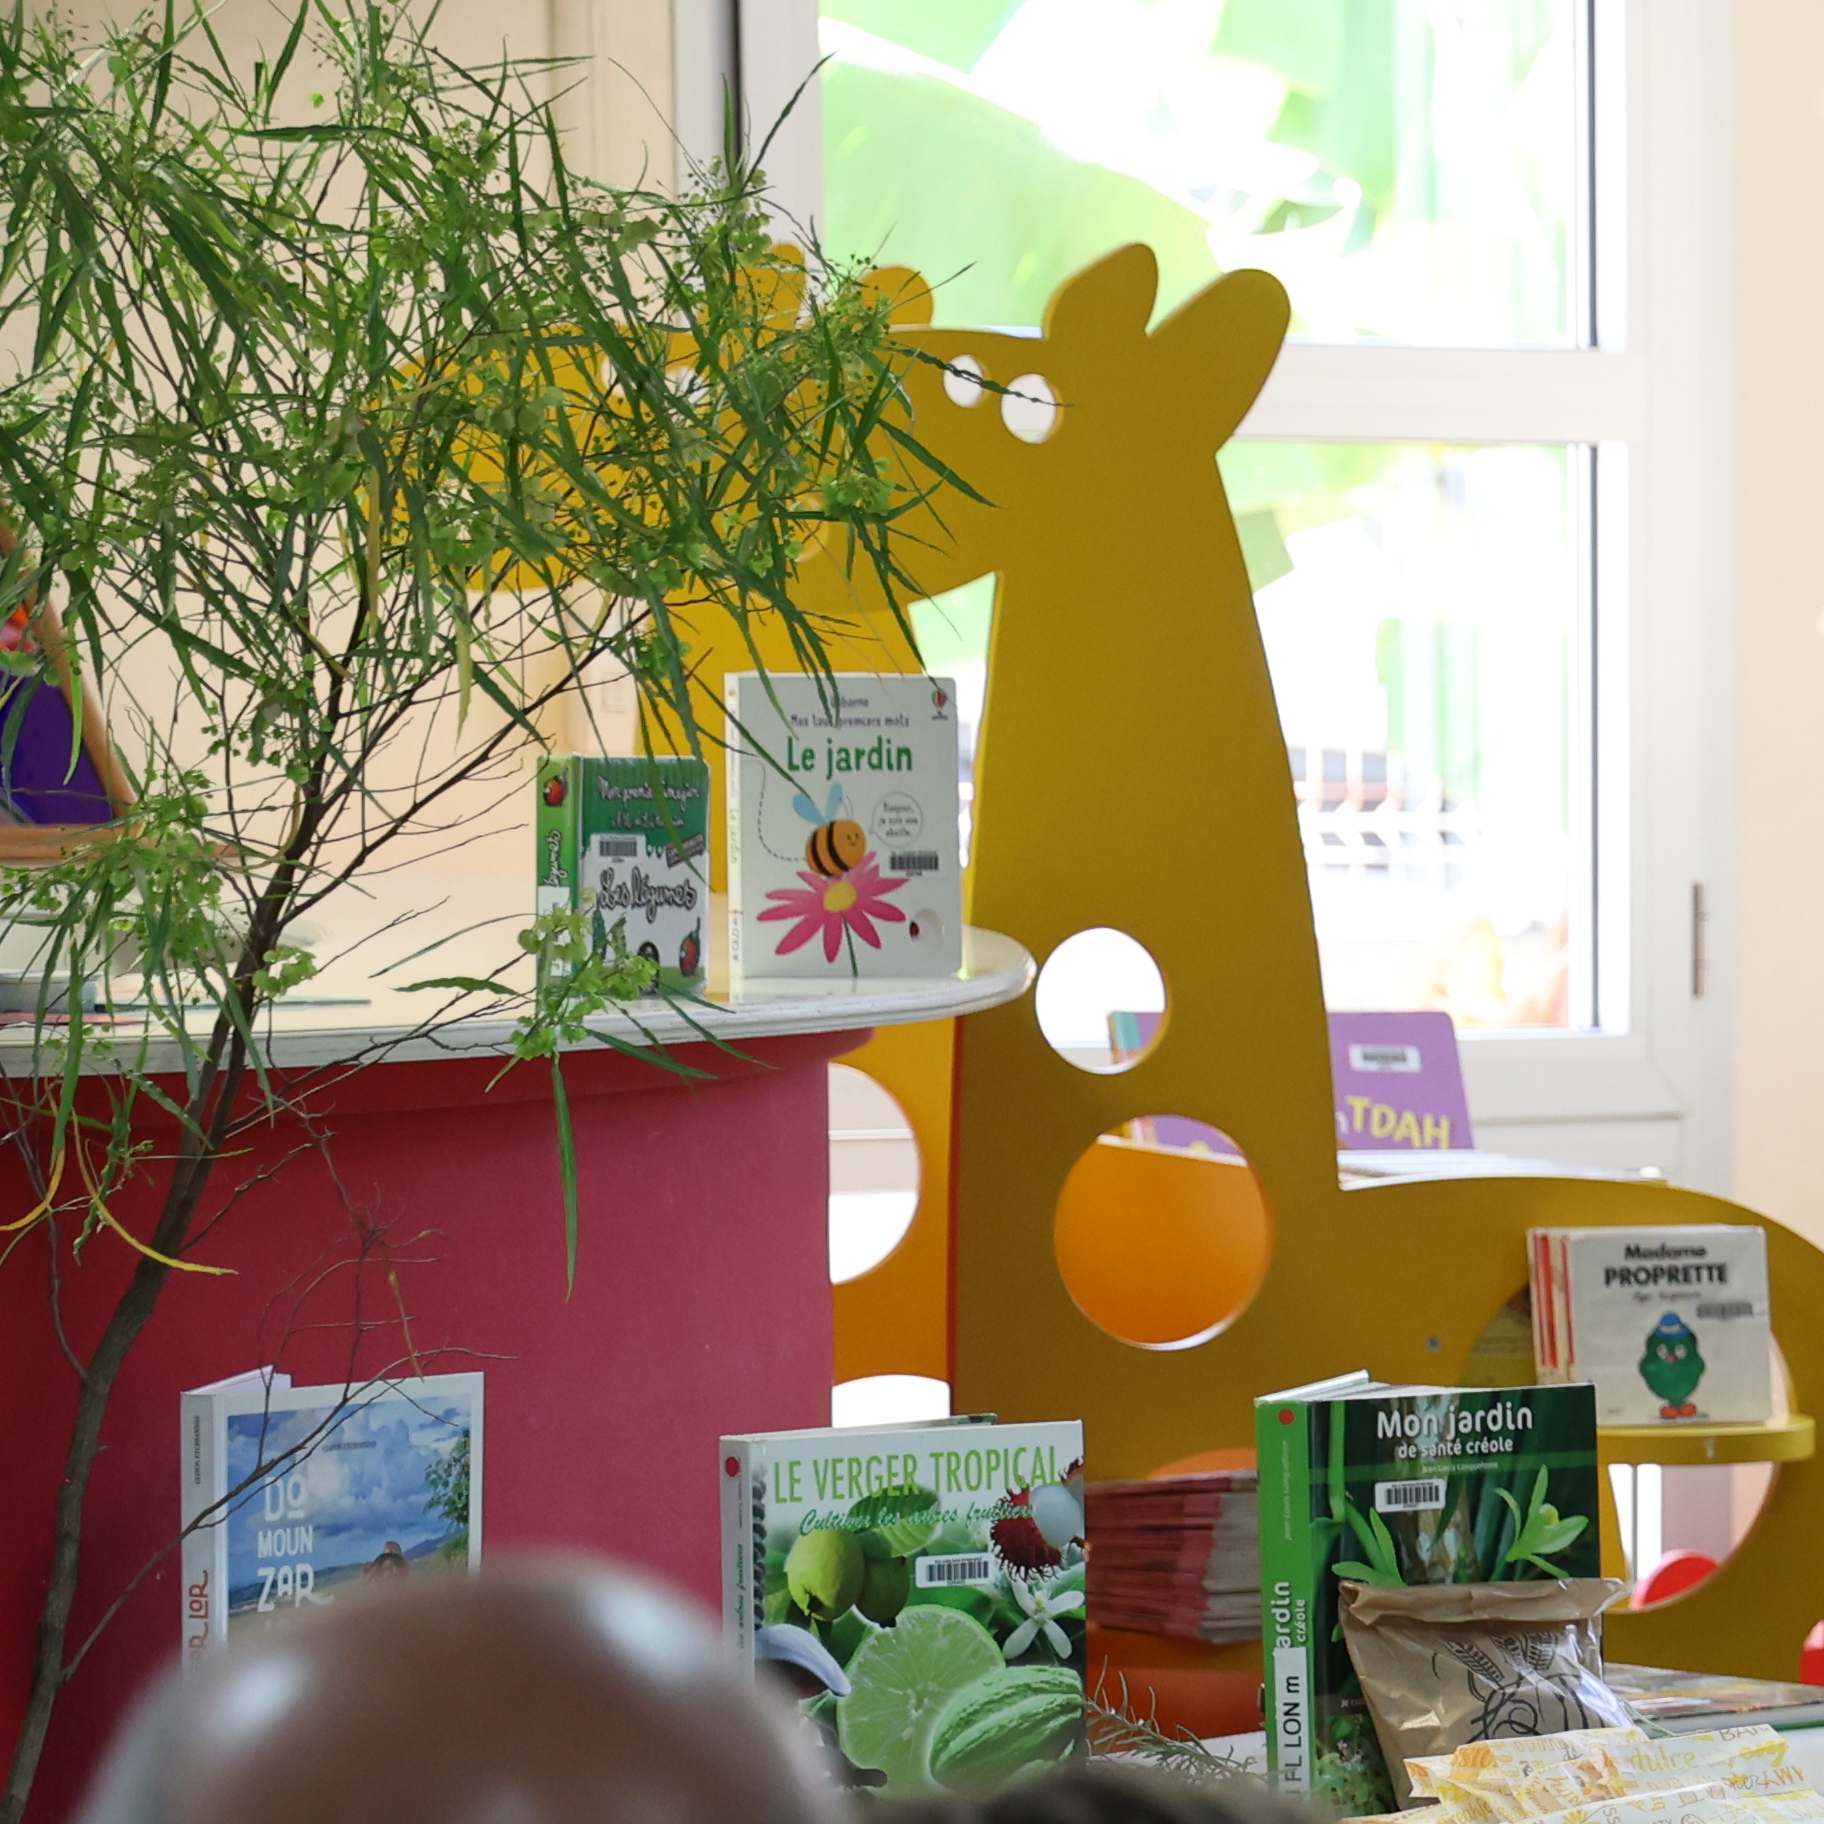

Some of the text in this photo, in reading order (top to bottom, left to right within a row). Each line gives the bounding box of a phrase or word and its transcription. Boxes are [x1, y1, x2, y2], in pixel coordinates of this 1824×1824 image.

[791, 714, 809, 727] Mes
[884, 713, 909, 727] mots
[786, 735, 815, 771] Le
[826, 734, 913, 781] jardin
[598, 865, 699, 923] Les légumes
[1345, 1094, 1450, 1150] TDAH
[1625, 1242, 1707, 1260] Madame
[1604, 1263, 1727, 1287] PROPRETTE
[1377, 1400, 1533, 1440] Mon jardin
[1398, 1436, 1514, 1459] de santé créole
[774, 1460, 802, 1504] LE
[813, 1454, 921, 1501] VERGER
[929, 1446, 1062, 1493] TROPICAL
[257, 1525, 314, 1558] MOUN
[799, 1508, 872, 1537] Cultiver
[877, 1506, 899, 1526] les
[257, 1563, 334, 1613] ZAR
[1271, 1581, 1292, 1650] ardin
[1294, 1599, 1308, 1643] créole
[1285, 1676, 1299, 1694] m
[1283, 1700, 1303, 1748] LON
